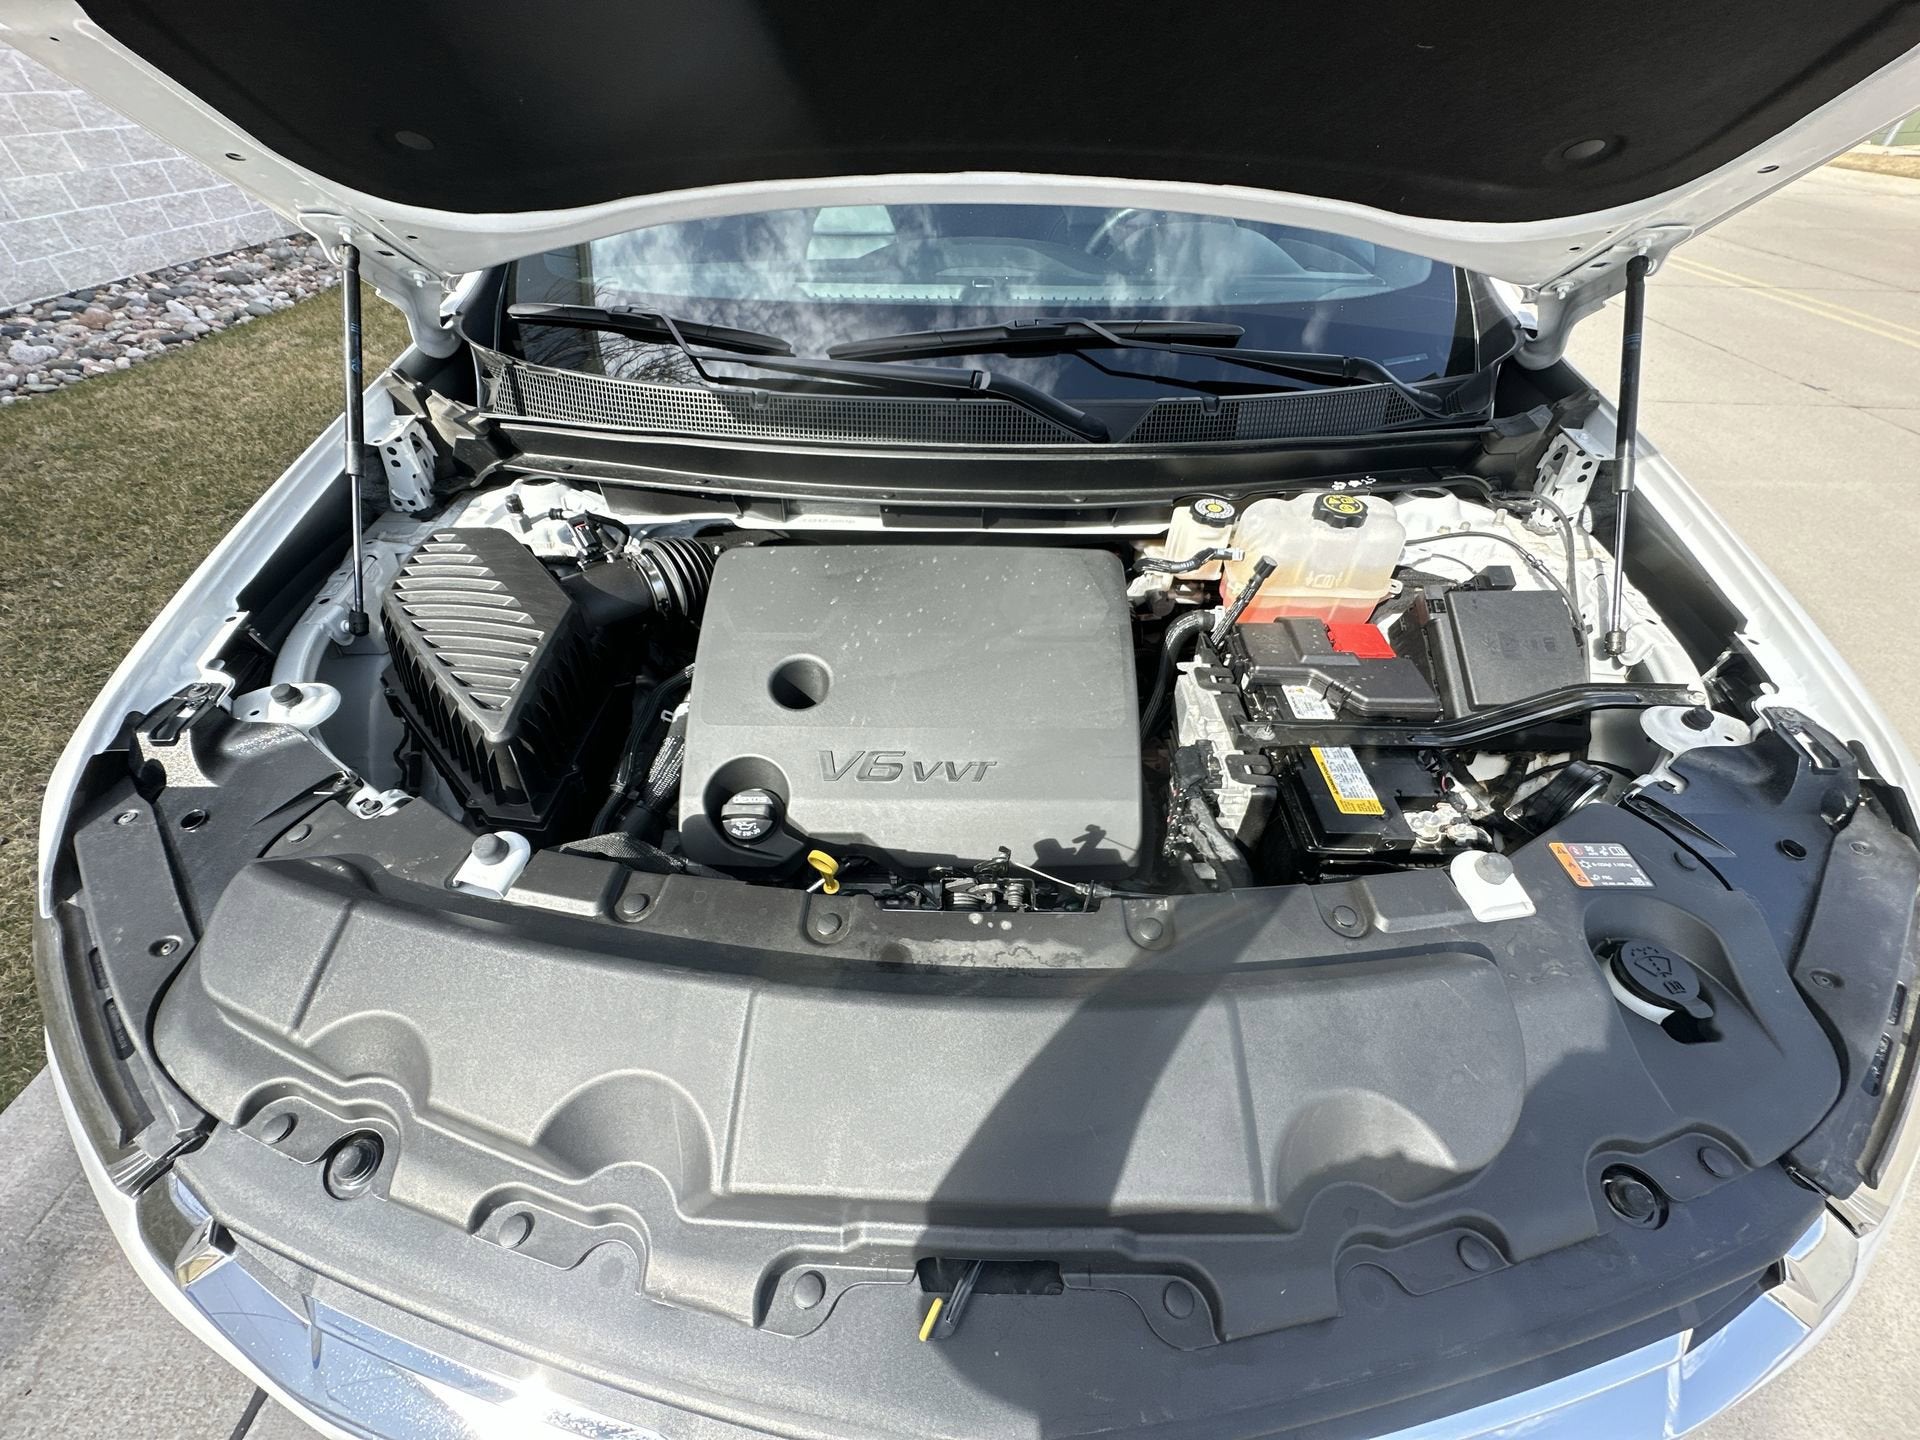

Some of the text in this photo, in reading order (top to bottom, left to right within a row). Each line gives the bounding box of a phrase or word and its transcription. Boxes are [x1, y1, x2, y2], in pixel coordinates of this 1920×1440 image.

[818, 750, 998, 782] V6 VVT
[732, 794, 768, 804] dexos
[731, 827, 742, 836] SAE
